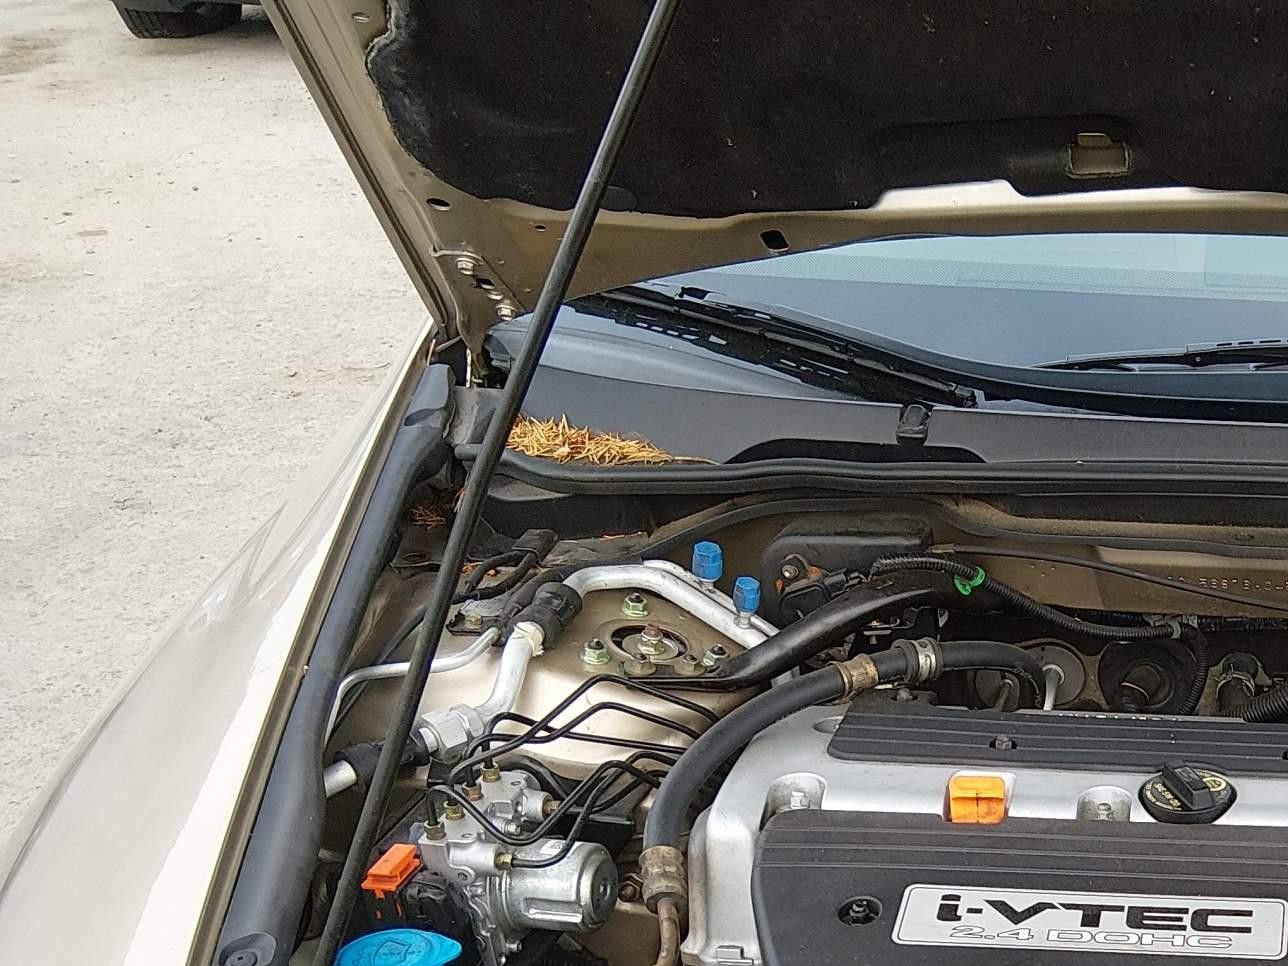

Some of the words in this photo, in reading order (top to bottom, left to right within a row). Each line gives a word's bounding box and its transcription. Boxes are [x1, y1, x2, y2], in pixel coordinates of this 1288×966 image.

[936, 893, 1254, 933] i-VTEC
[950, 925, 1034, 942] 2.4
[1046, 929, 1233, 949] DOHC
